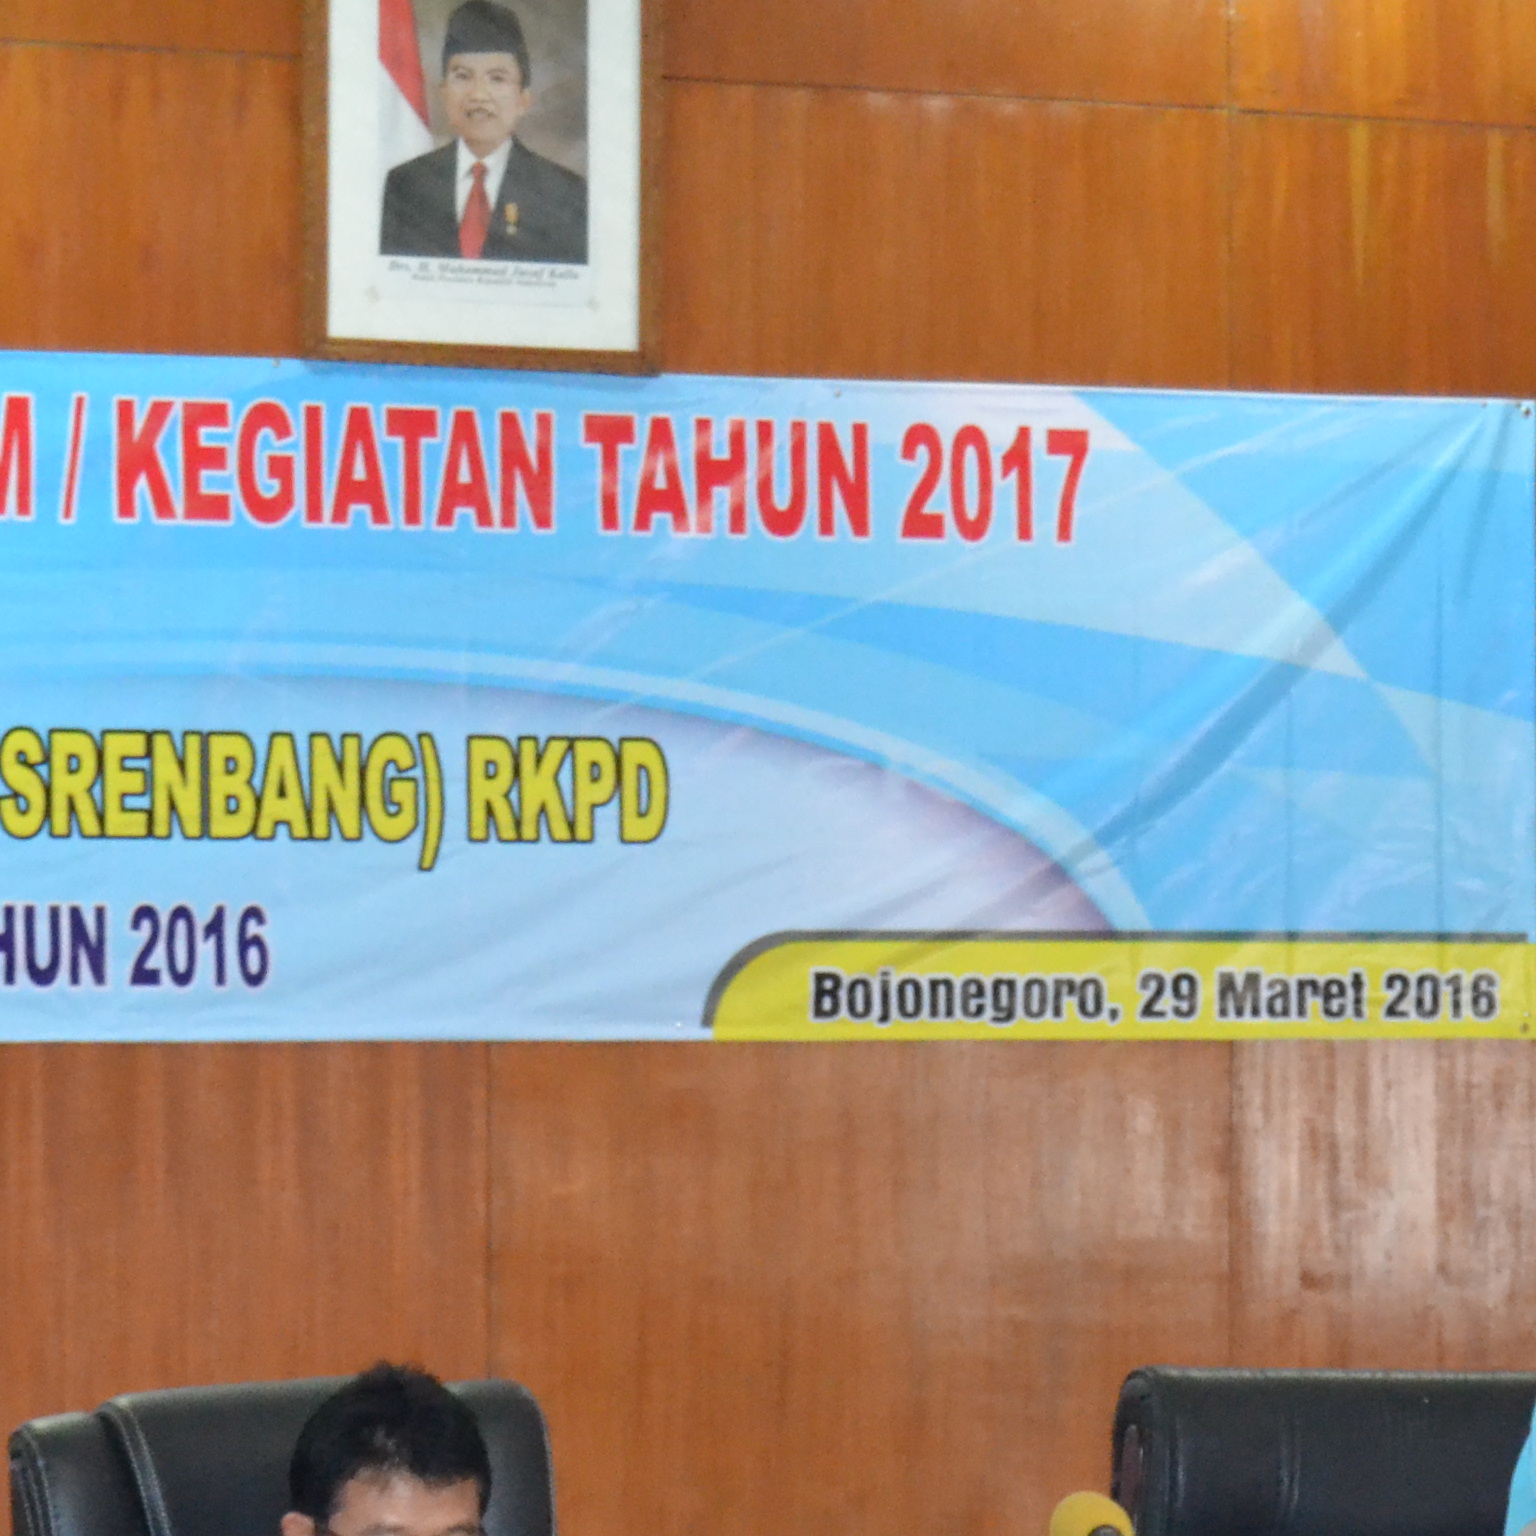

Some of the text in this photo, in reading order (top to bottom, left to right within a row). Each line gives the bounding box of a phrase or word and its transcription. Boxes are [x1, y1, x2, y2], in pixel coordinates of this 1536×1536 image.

[62, 395, 86, 520] /
[115, 398, 555, 531] KEGIATAN
[583, 413, 871, 539] TAHUN
[900, 421, 1090, 544] 2017
[466, 735, 670, 844] RKPD
[129, 904, 269, 988] 2016
[811, 970, 1498, 1025] Bojonegoro, 29 Maret 2016
